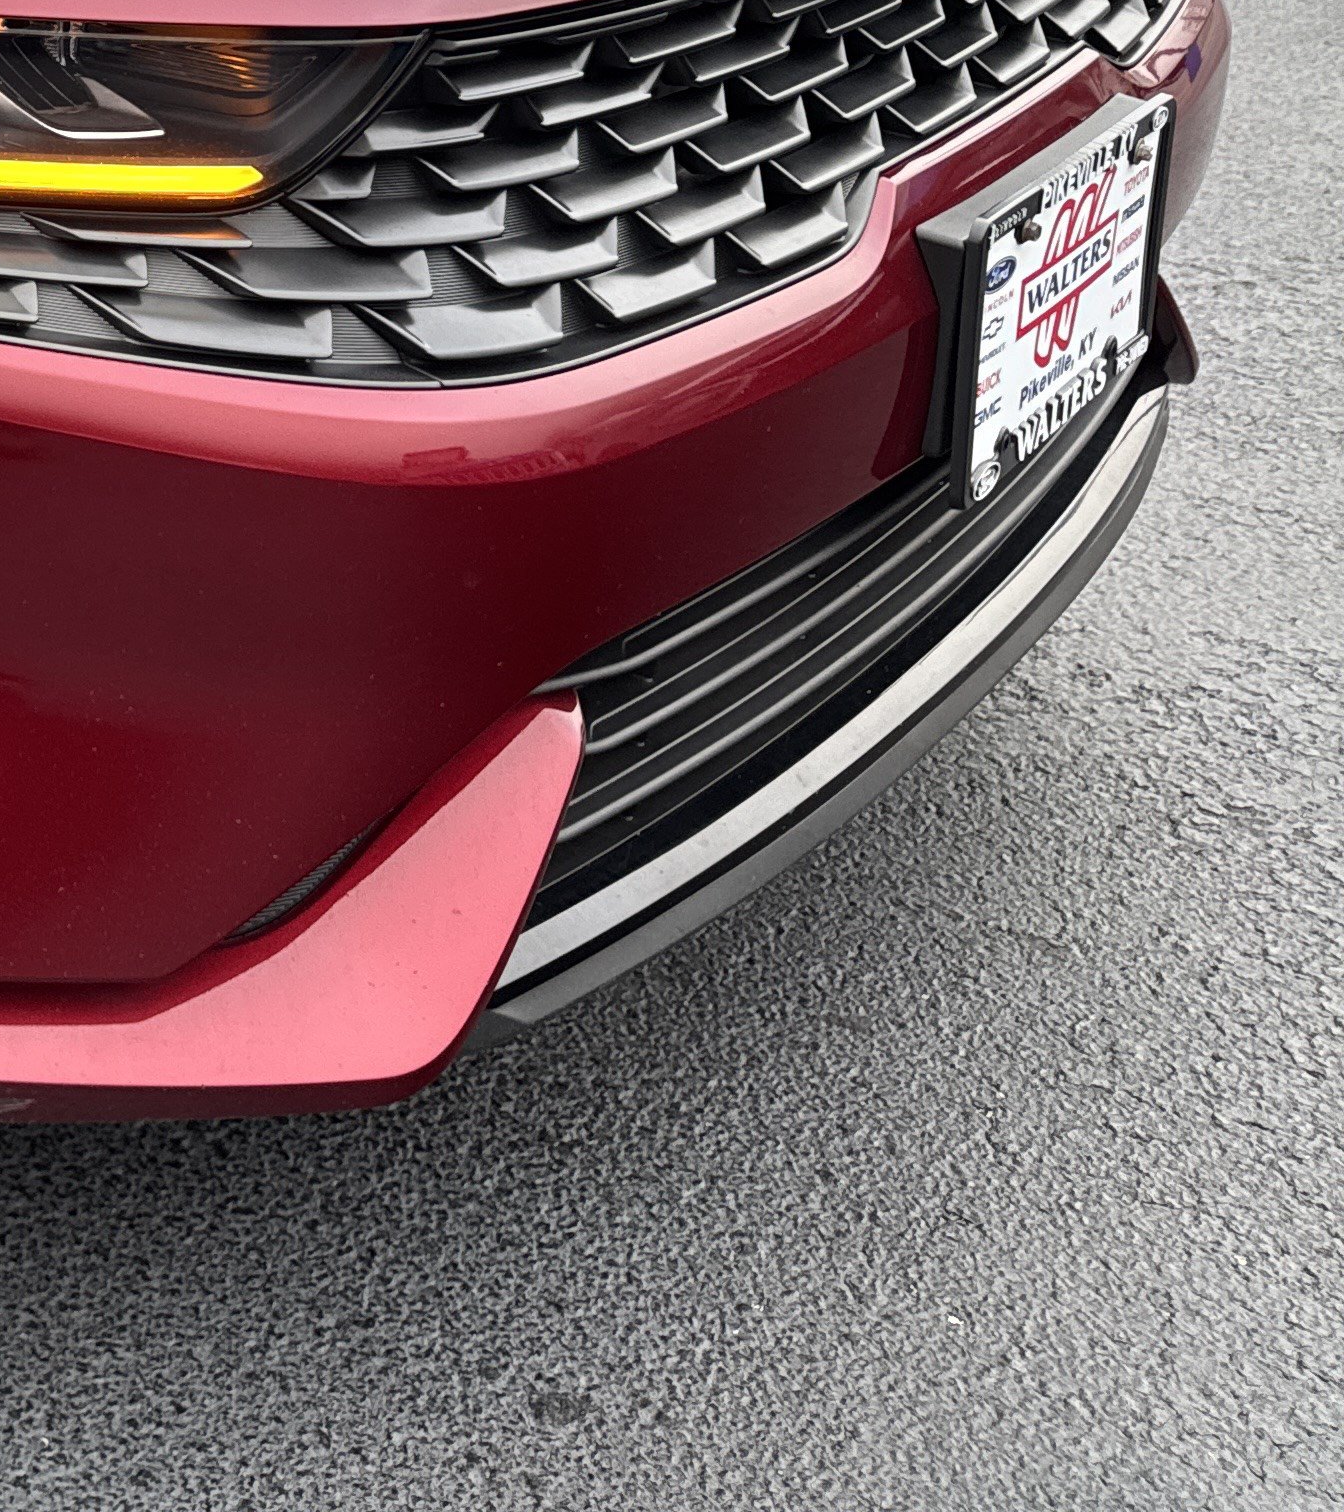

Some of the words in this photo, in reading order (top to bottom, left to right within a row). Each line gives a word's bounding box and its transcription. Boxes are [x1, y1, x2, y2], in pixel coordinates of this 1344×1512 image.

[1027, 229, 1112, 314] WALTERS
[1113, 255, 1140, 287] NISSAN
[1019, 354, 1074, 410] Pikeville,
[1078, 326, 1098, 361] KY
[1014, 359, 1108, 462] WALTERS
